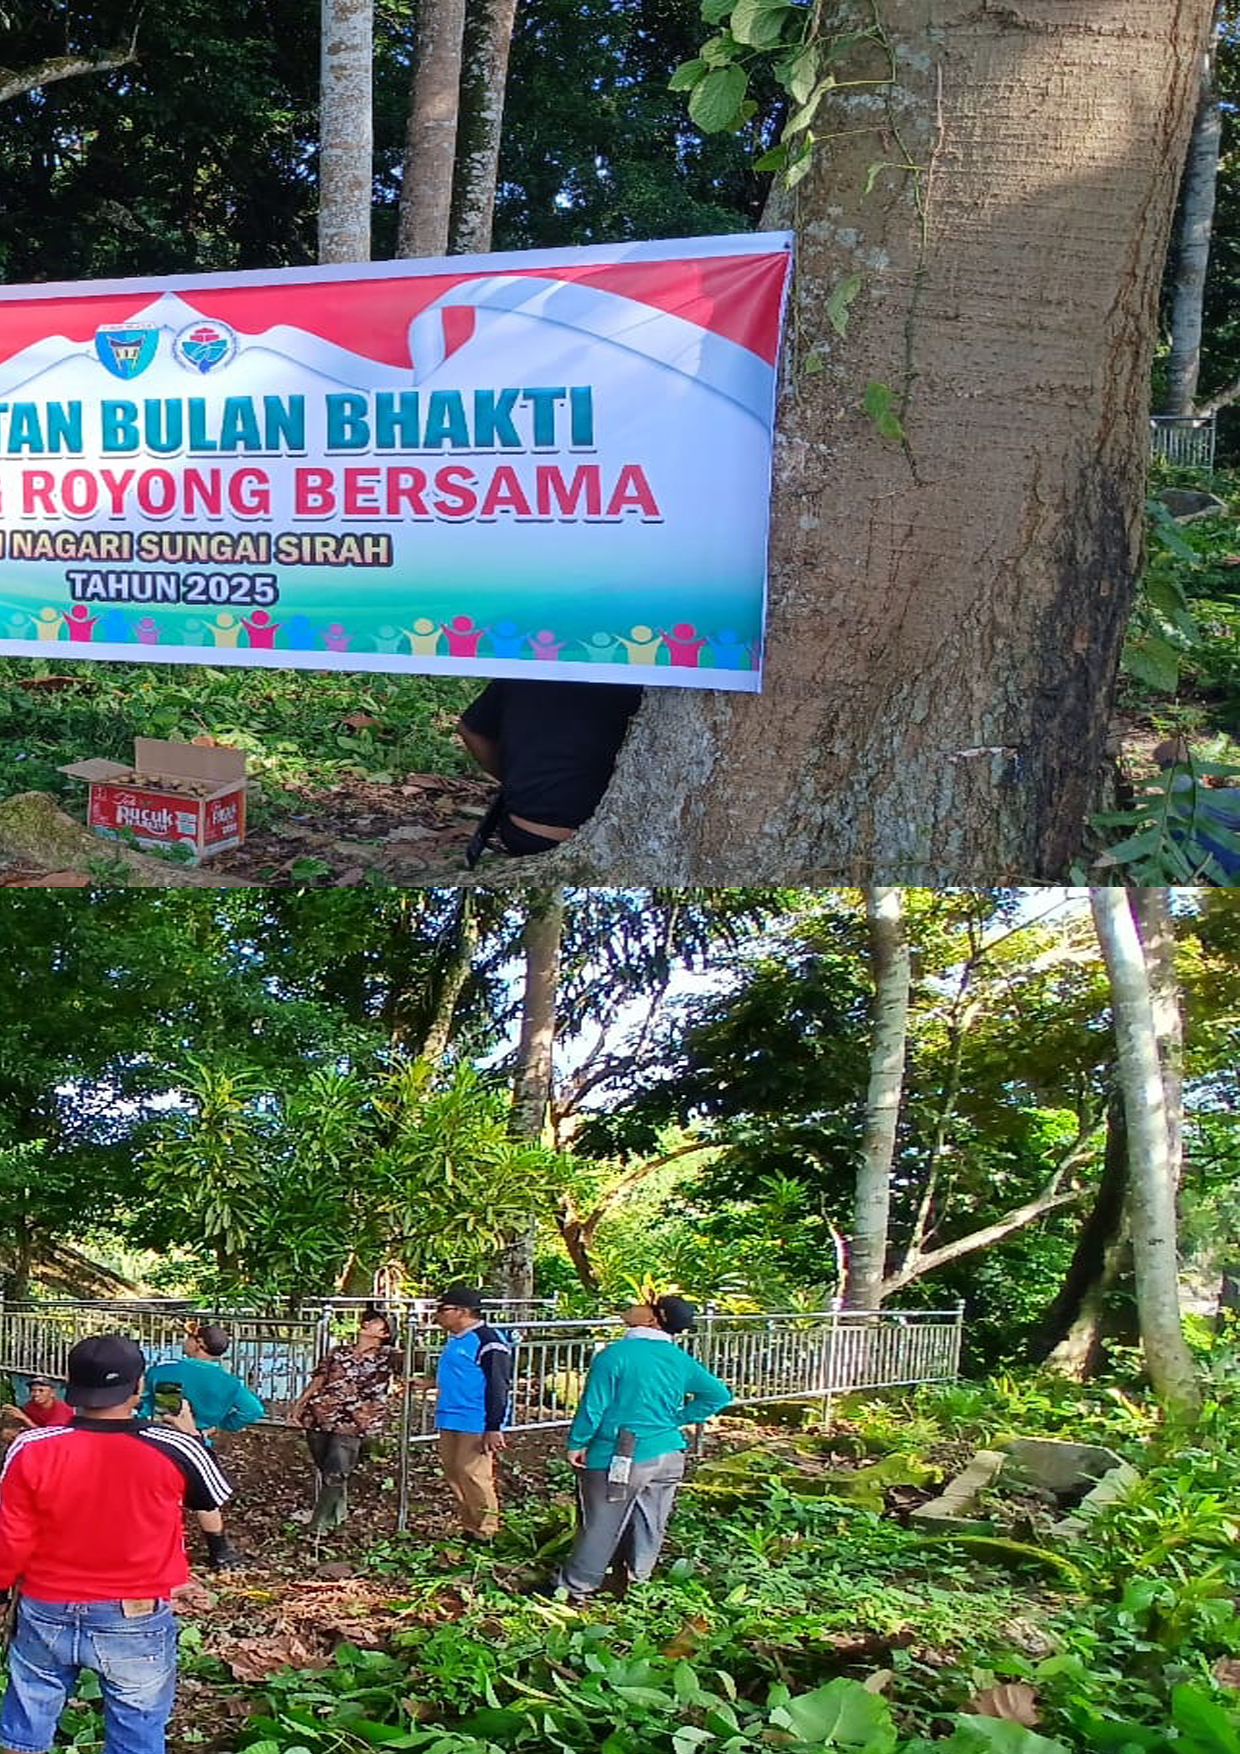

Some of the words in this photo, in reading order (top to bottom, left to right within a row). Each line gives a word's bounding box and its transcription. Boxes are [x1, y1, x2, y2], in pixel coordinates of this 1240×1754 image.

[100, 396, 306, 458] BULAN
[324, 385, 596, 456] BHAKTI
[21, 468, 272, 520] ROYONG
[292, 464, 664, 523] BERSAMA
[9, 531, 133, 562] NAGARI
[138, 531, 270, 564] SUNGAI
[277, 533, 393, 566] SIRAH
[66, 571, 180, 603] TAHUN
[185, 572, 279, 605] 2025
